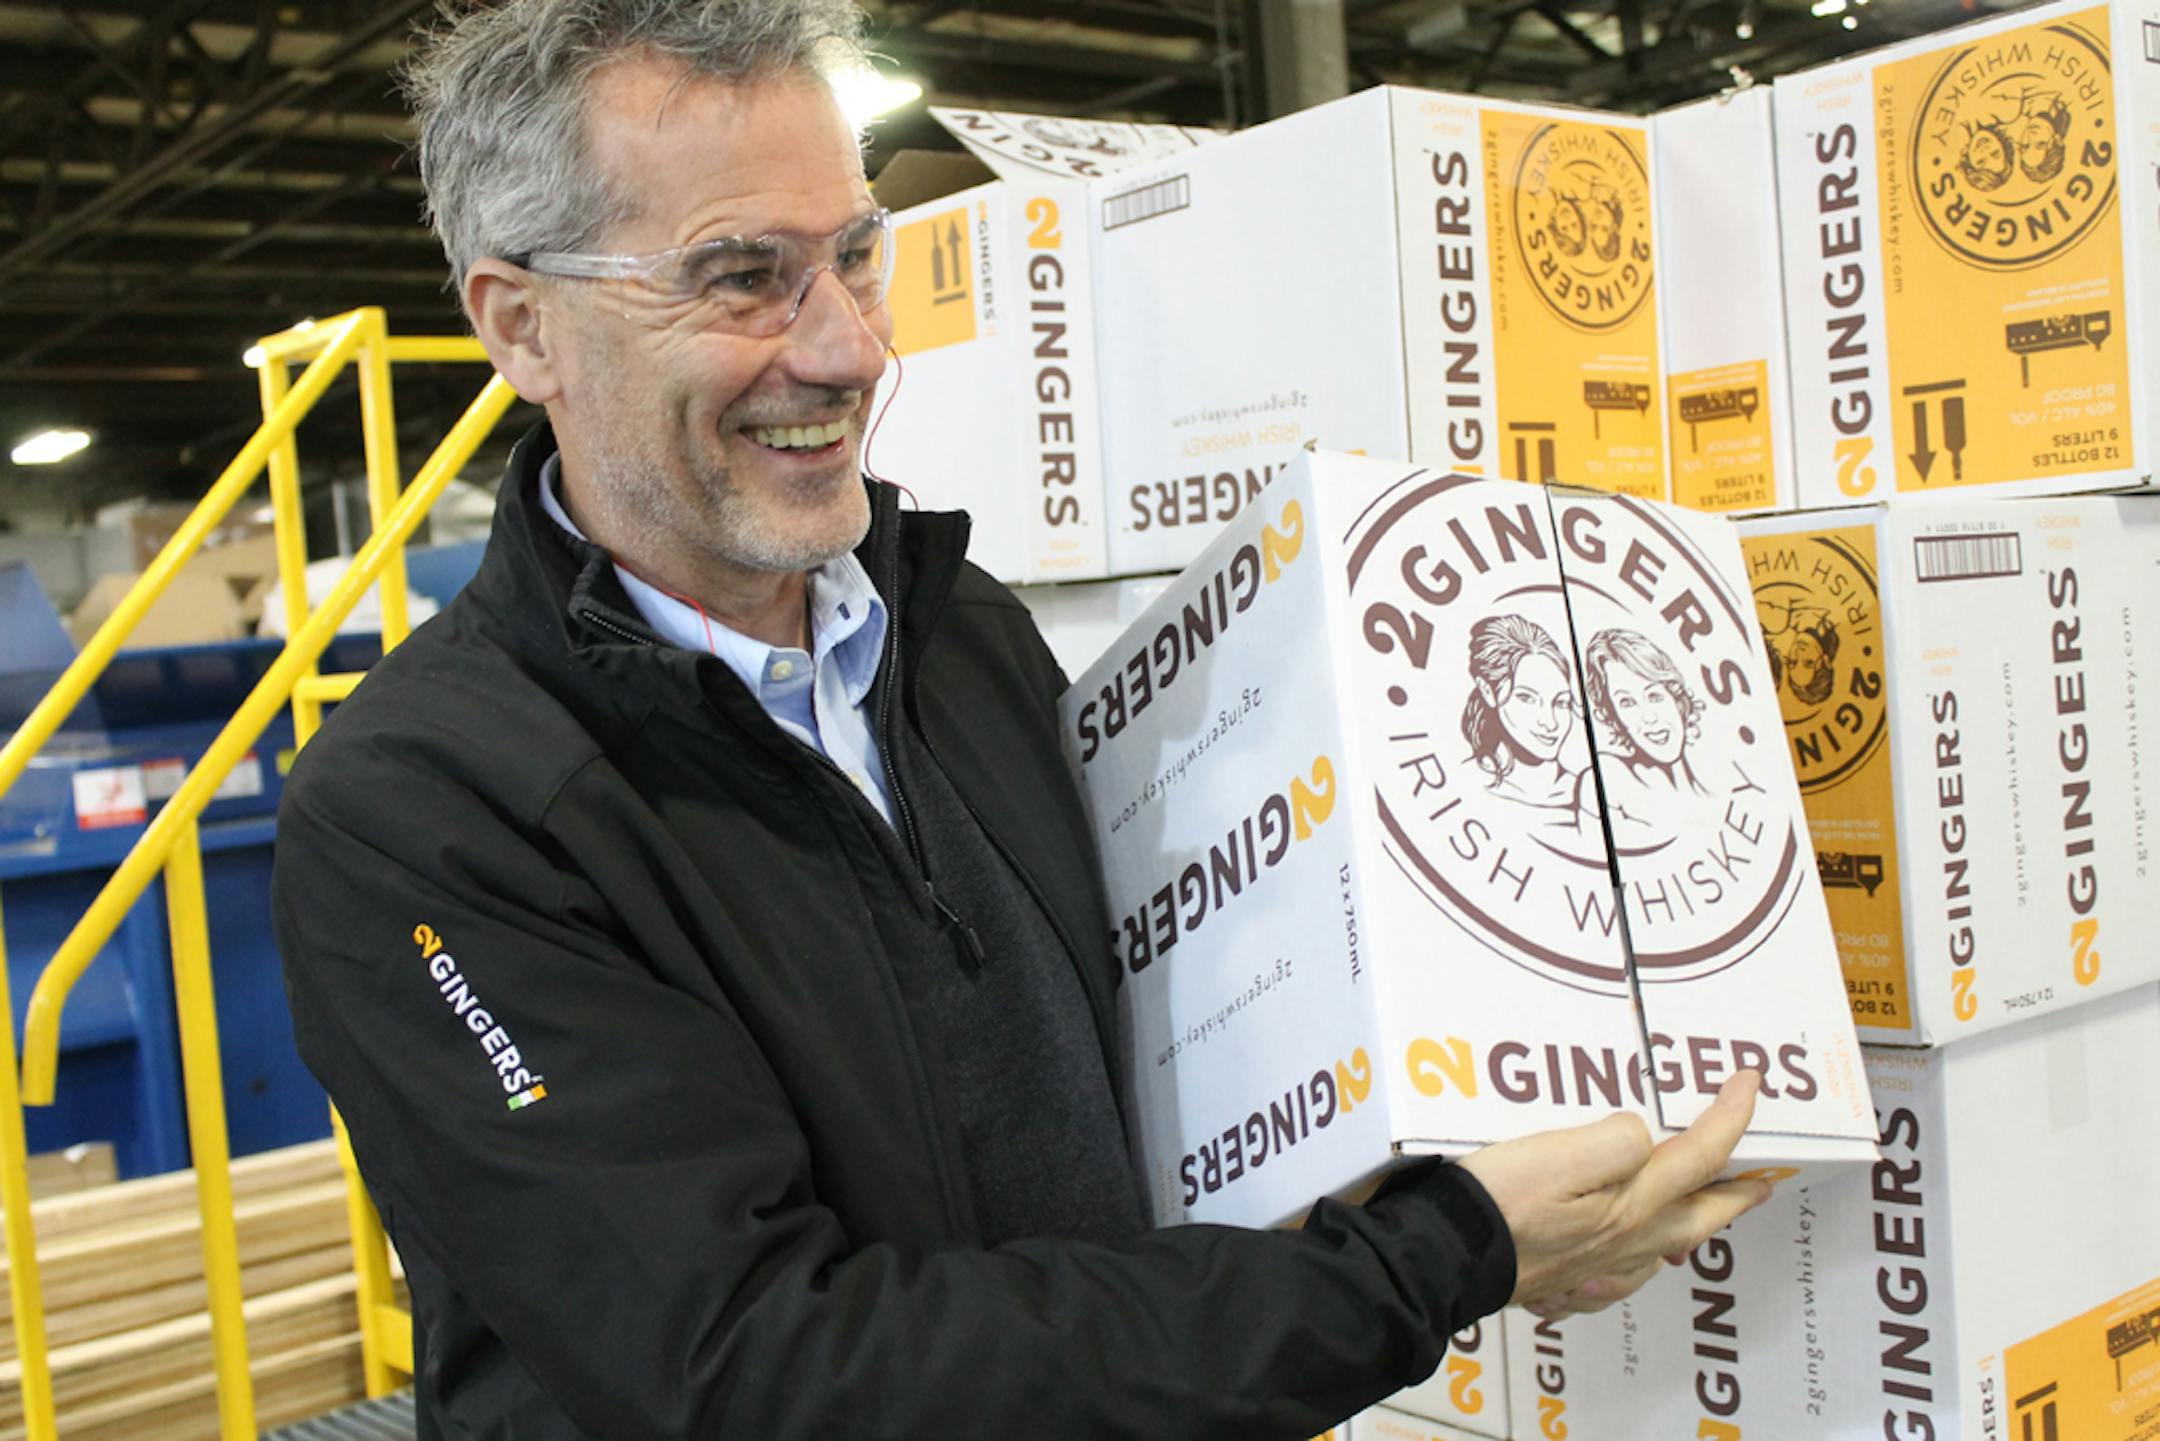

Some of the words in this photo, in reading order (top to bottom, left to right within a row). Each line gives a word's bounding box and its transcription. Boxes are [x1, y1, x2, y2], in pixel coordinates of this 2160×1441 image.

[1935, 42, 2033, 147] WHISKEY
[2045, 45, 2104, 112] IRISH
[1526, 133, 1599, 202] WHISKEY
[1879, 84, 1904, 294] 2gingerswhiskey.com
[1930, 139, 2114, 248] 2GINGERS
[1432, 150, 1485, 475] GINGERS
[1527, 229, 1653, 312] 2GINGERS
[1816, 123, 1877, 498] 2GINGERS
[1026, 196, 1080, 527] 2GINGERS
[2040, 385, 2094, 405] PROOF
[2032, 447, 2100, 467] BOTTLES
[2052, 429, 2105, 448] LITERS
[2105, 446, 2120, 459] 12
[2109, 427, 2119, 440] 9
[1130, 463, 1287, 532] NGERS
[1078, 498, 1305, 764] 2GINGERS
[1362, 502, 1752, 706] 2GINGERS
[1811, 558, 1873, 637] IRISH
[1110, 686, 1263, 834] 2gingerswhiskey.com
[1793, 667, 1882, 768] 2GIN
[2122, 606, 2147, 879] 2gingerswhiskey.com
[2001, 661, 2028, 908] 2gingerswhiskey.com
[2047, 566, 2101, 987] 2GINGERS
[1338, 862, 1350, 885] 12
[1387, 732, 1535, 902] IRISH
[1563, 760, 1767, 938] WHISKEY
[1931, 690, 1978, 1022] 2GINGERS
[1834, 931, 1867, 947] PRO
[1845, 980, 1880, 995] LITE
[1885, 982, 1896, 995] 9
[412, 923, 531, 1094] 2GINGERS
[1157, 957, 1294, 1067] 2gingerswhiskey.com
[1880, 1001, 1897, 1015] 12
[1406, 1033, 1818, 1108] 2GINGERS
[1864, 1054, 1929, 1072] WHISKE
[1180, 1046, 1373, 1207] 2GINGERS
[1689, 1228, 1742, 1441] GING
[1795, 1186, 1827, 1417] 2gingerswhiskey.
[1533, 1319, 1568, 1441] 2GIN
